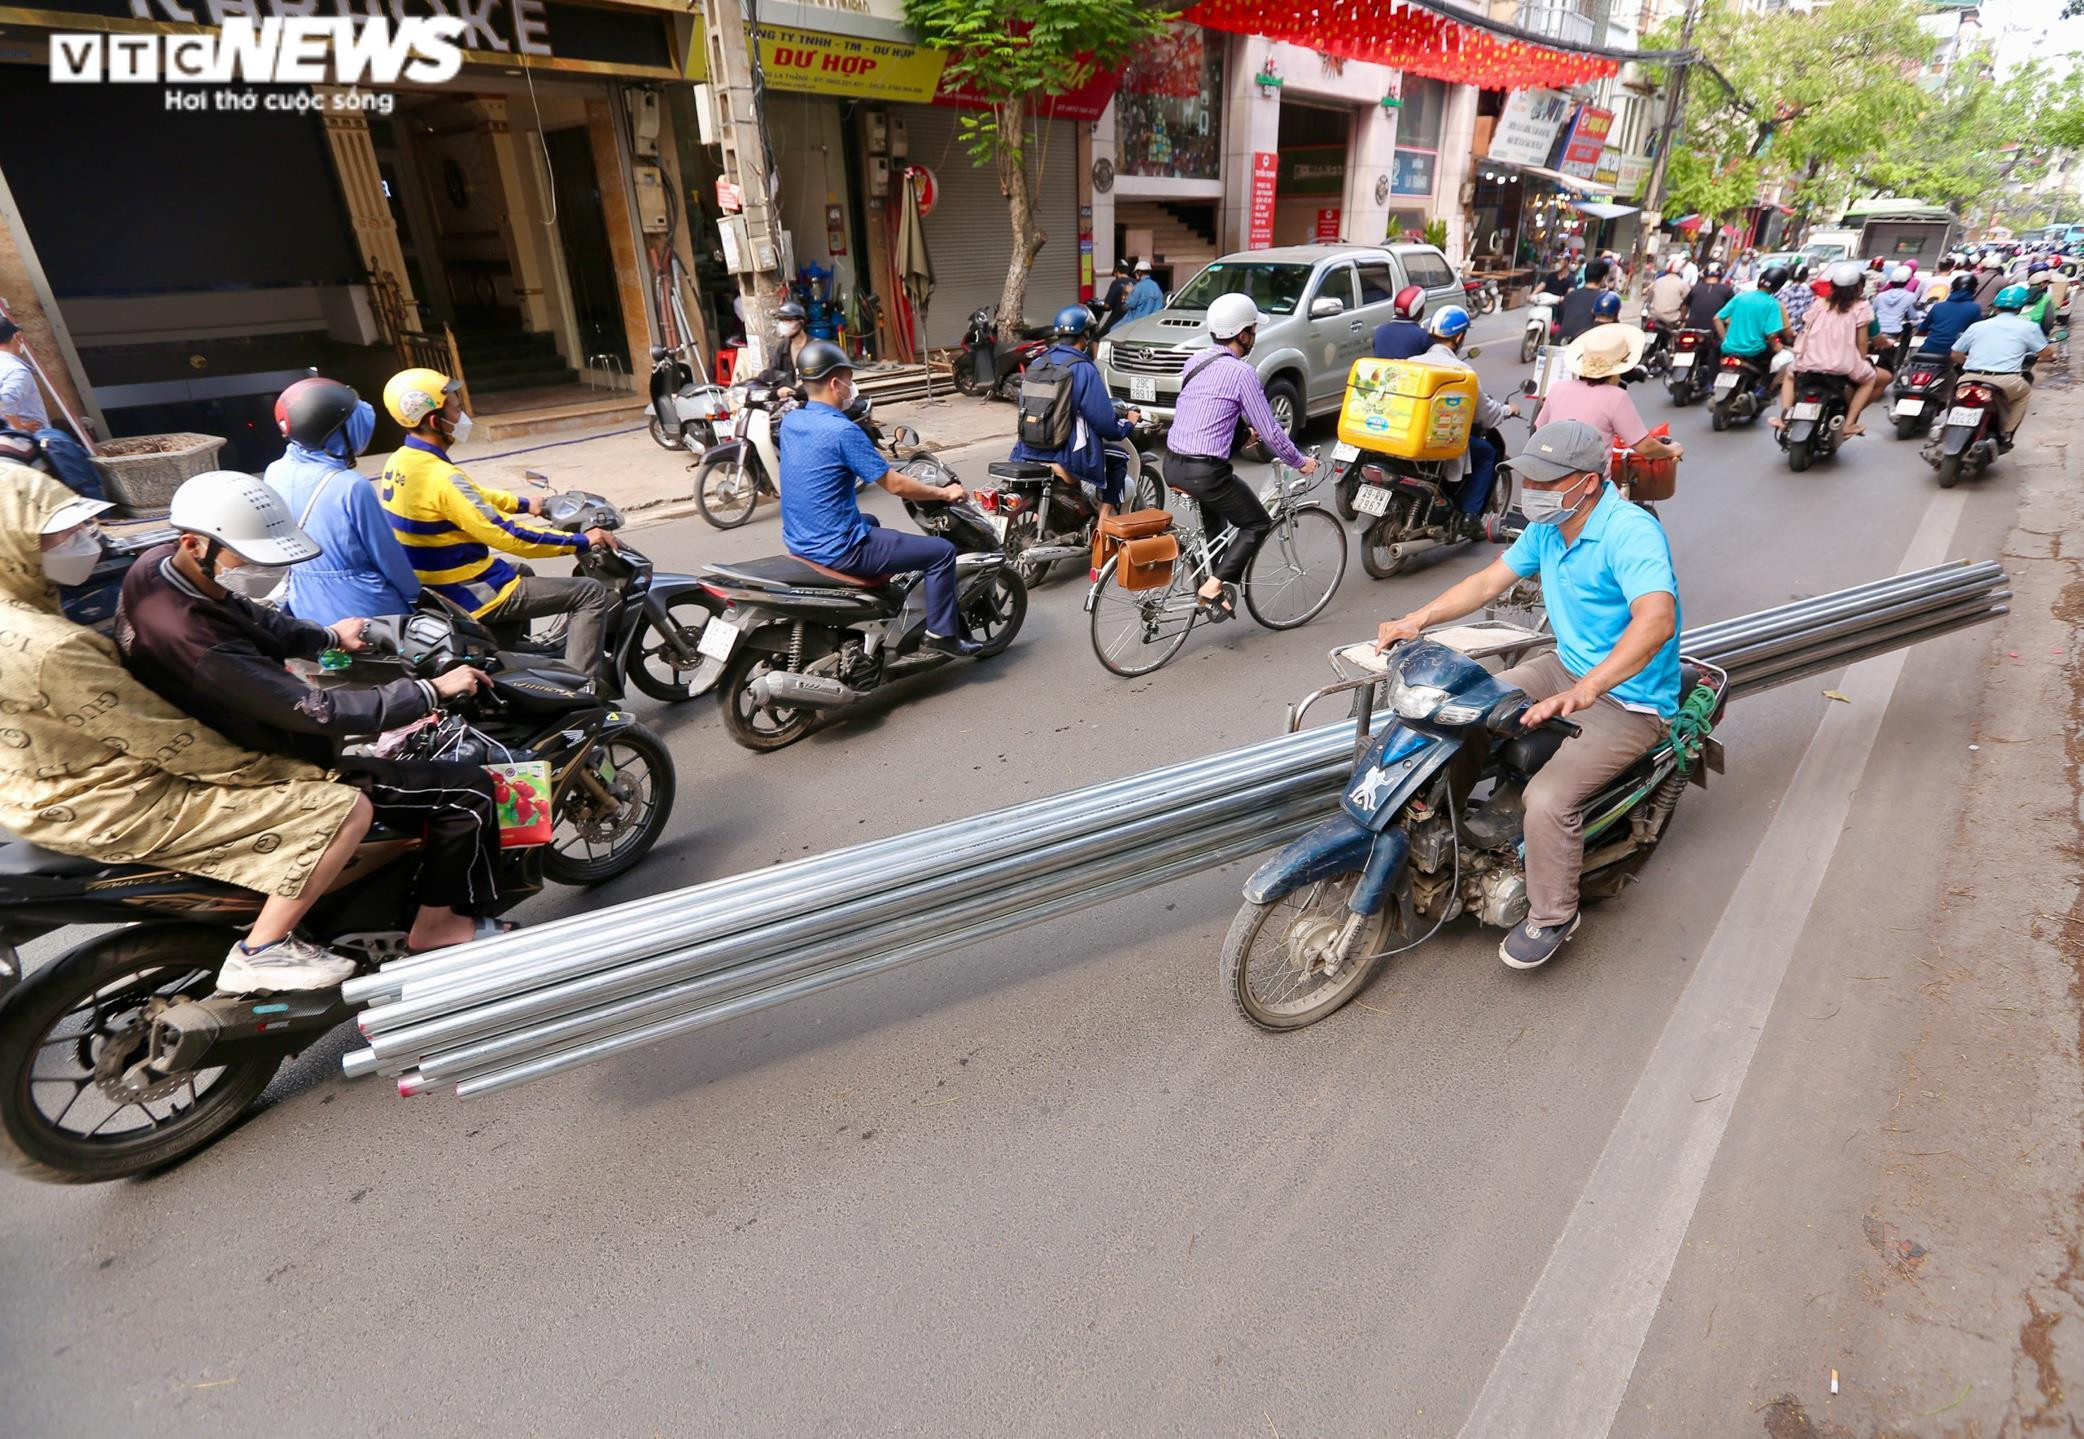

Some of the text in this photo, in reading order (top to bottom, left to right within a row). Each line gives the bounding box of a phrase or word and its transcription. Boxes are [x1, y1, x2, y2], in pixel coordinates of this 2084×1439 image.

[781, 32, 795, 43] TY
[800, 35, 832, 48] TNHH
[844, 41, 862, 52] TM
[774, 47, 877, 78] DƯ HỢP
[277, 828, 333, 898] GUCCI
